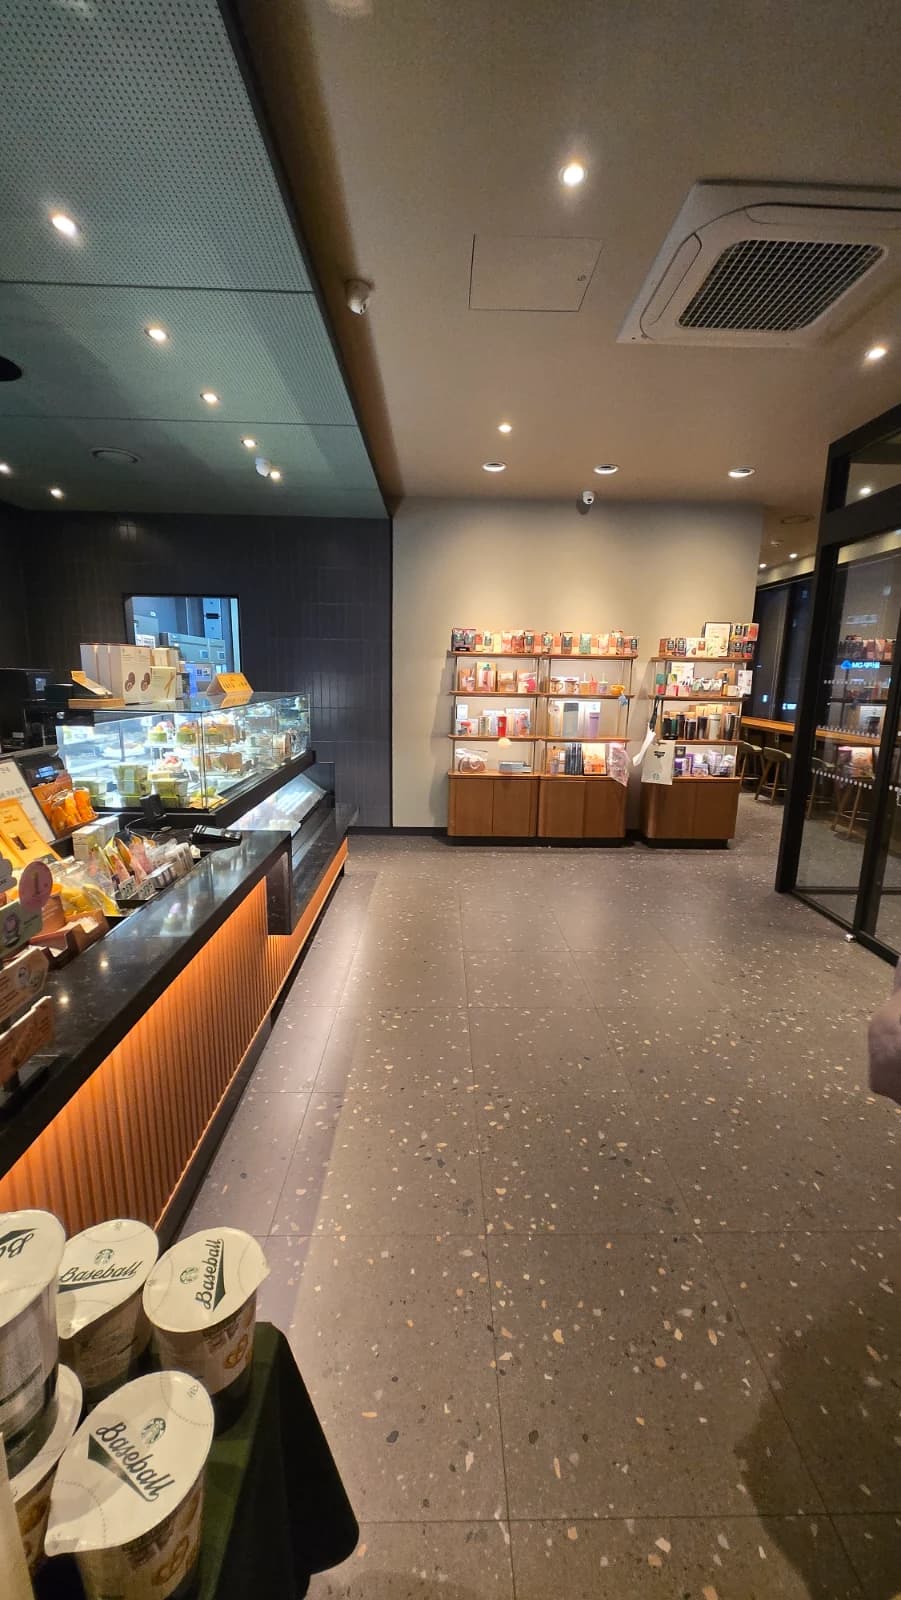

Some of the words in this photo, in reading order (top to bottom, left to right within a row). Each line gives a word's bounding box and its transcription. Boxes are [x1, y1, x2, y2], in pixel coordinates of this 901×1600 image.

[59, 1260, 143, 1283] Baseball
[195, 1238, 222, 1310] Baseball
[96, 1421, 175, 1500] Baseball
